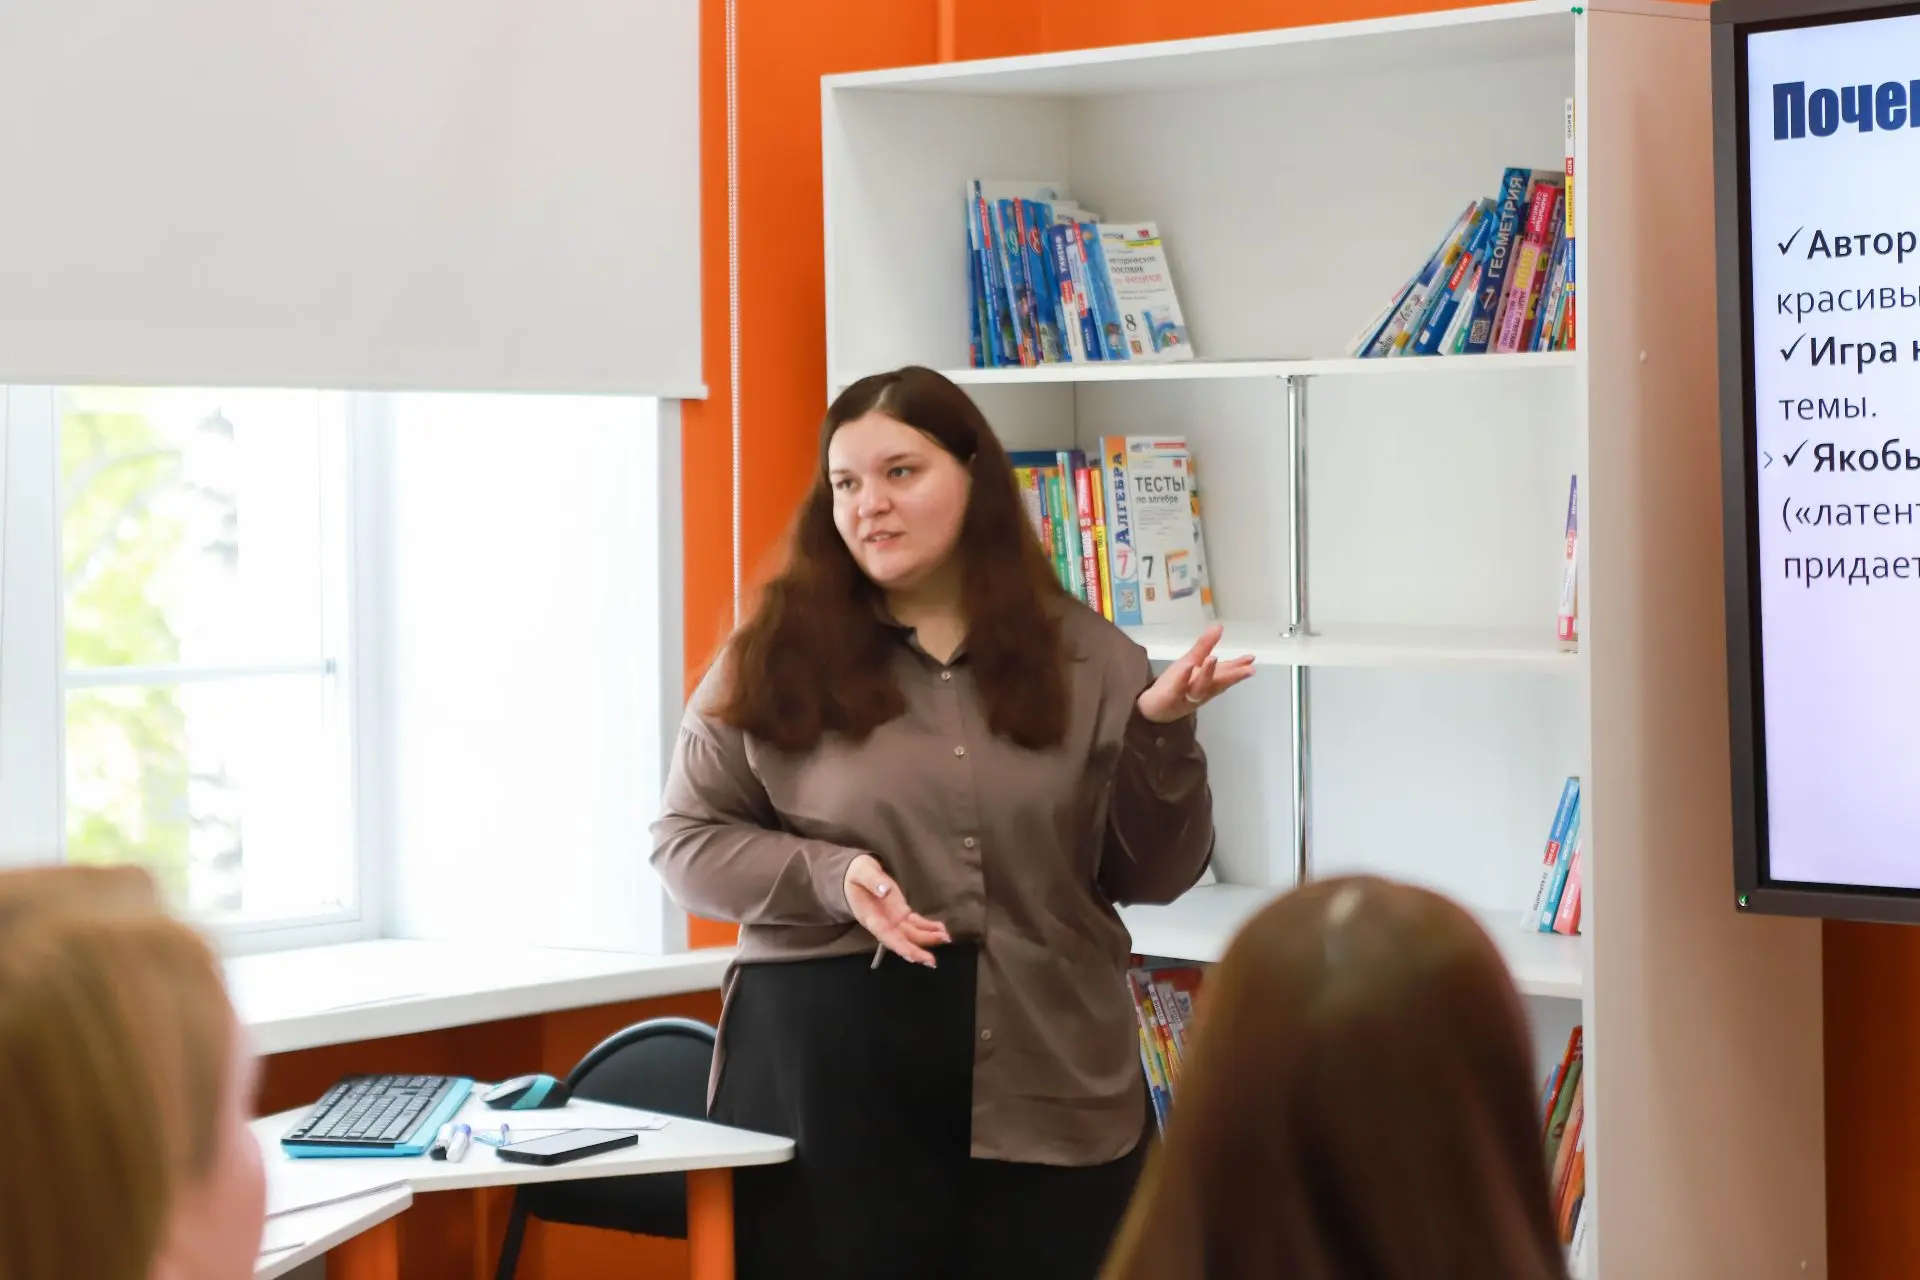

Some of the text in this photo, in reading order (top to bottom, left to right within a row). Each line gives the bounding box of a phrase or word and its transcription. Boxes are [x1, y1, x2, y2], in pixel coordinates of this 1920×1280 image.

[1488, 176, 1524, 279] ГЕОМЕТРИЯ
[1807, 229, 1917, 264] Автор
[1125, 314, 1137, 332] 8
[1810, 336, 1897, 374] Игра
[1779, 397, 1877, 421] темы.
[1134, 476, 1186, 493] ТЕСТЫ
[1116, 552, 1128, 577] 7
[1142, 555, 1154, 579] 7
